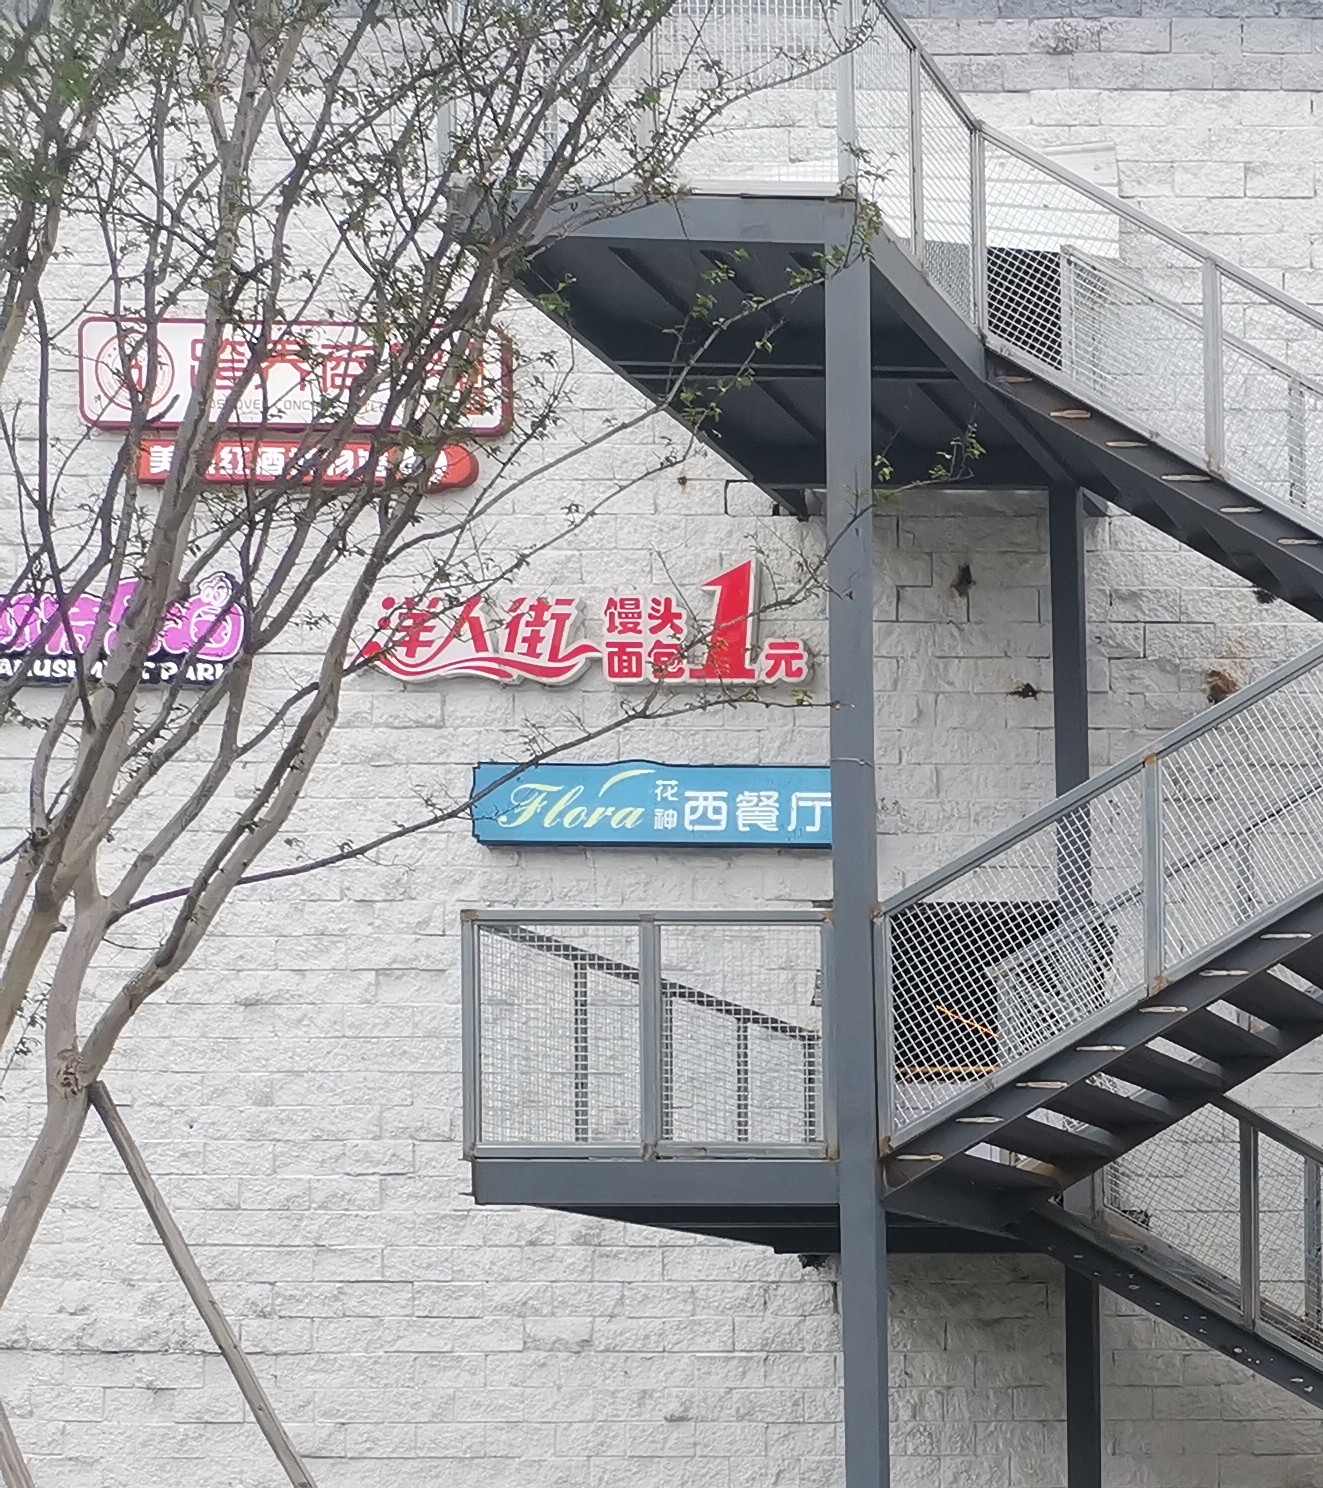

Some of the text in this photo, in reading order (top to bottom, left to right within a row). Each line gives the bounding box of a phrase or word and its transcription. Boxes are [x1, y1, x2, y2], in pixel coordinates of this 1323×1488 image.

[360, 596, 590, 672] 洋人街
[603, 597, 686, 636] 馒头
[604, 641, 691, 680] 面包
[497, 782, 647, 830] Flora
[684, 791, 832, 833] 西餐厅
